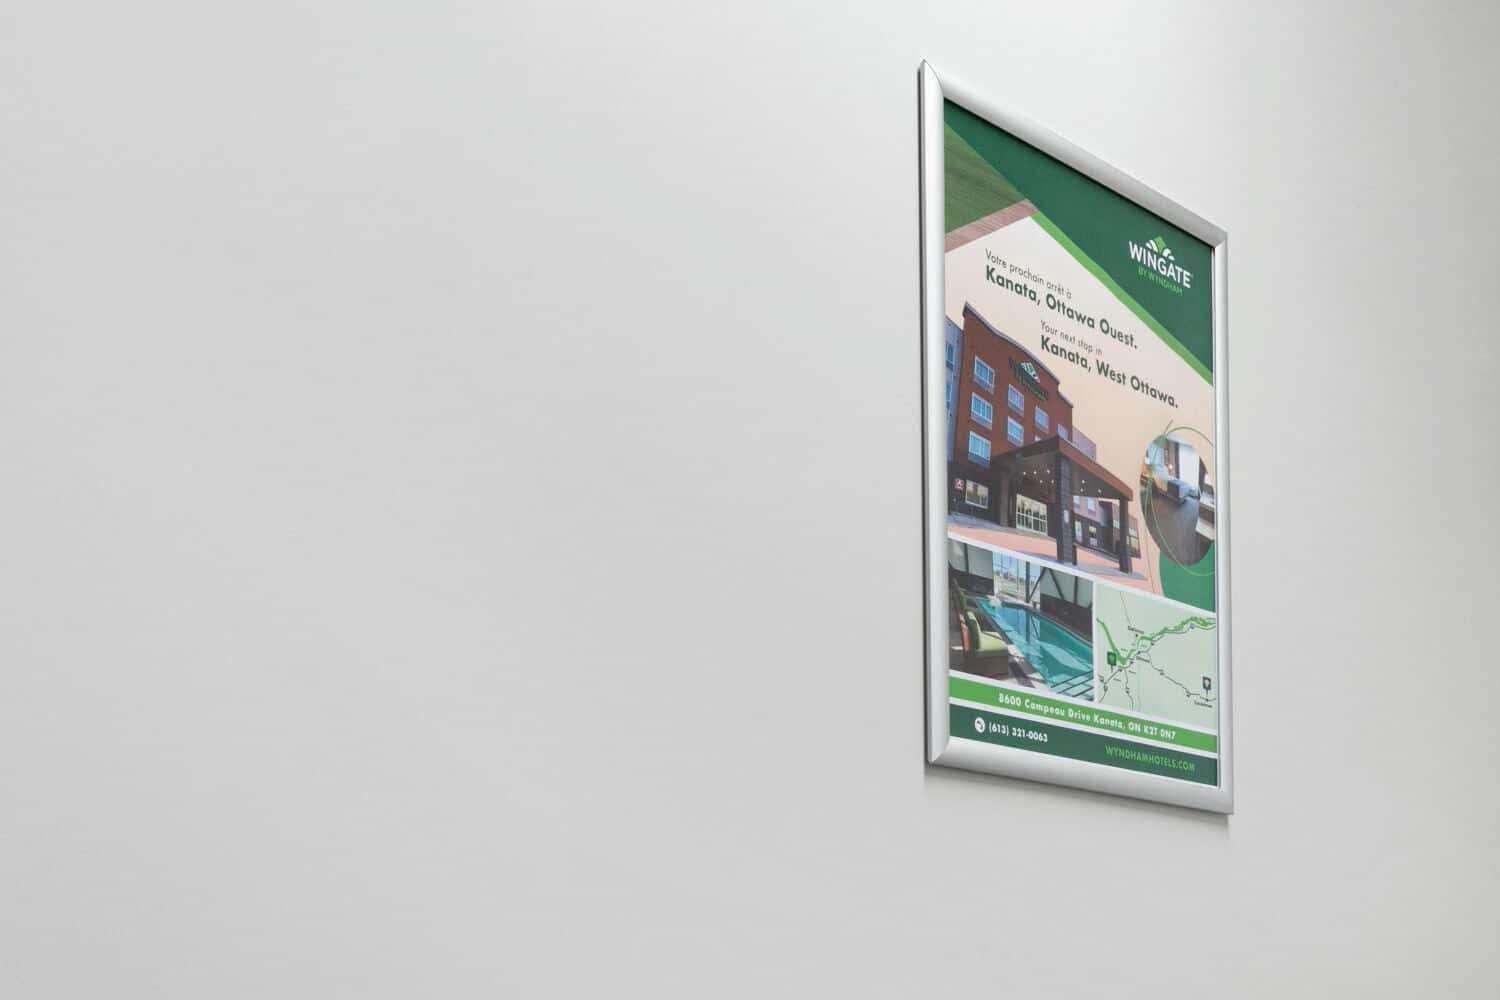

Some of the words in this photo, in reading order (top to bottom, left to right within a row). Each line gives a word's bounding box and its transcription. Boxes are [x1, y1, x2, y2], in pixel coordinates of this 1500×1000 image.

[985, 248, 1007, 268] Votre
[1010, 264, 1044, 285] prochain
[1128, 239, 1191, 289] WINGATE
[986, 265, 1040, 305] Kanata,
[1046, 294, 1095, 329] Ottawa
[1100, 319, 1138, 349] Ouest.
[1040, 320, 1058, 336] Your
[1060, 331, 1076, 345] next
[1077, 339, 1093, 353] stop
[1040, 335, 1092, 372] Kanata,
[1096, 359, 1127, 385] West
[1131, 375, 1179, 408] Ottawa.
[988, 721, 1010, 737] (613)
[1012, 727, 1048, 743] 321-0063
[1024, 699, 1065, 716] Campeau
[1068, 707, 1091, 722] Drive
[1094, 713, 1126, 730] Kanata,
[1128, 721, 1142, 733] ON
[1104, 744, 1196, 771] WYNDHAMHOTELS.COM
